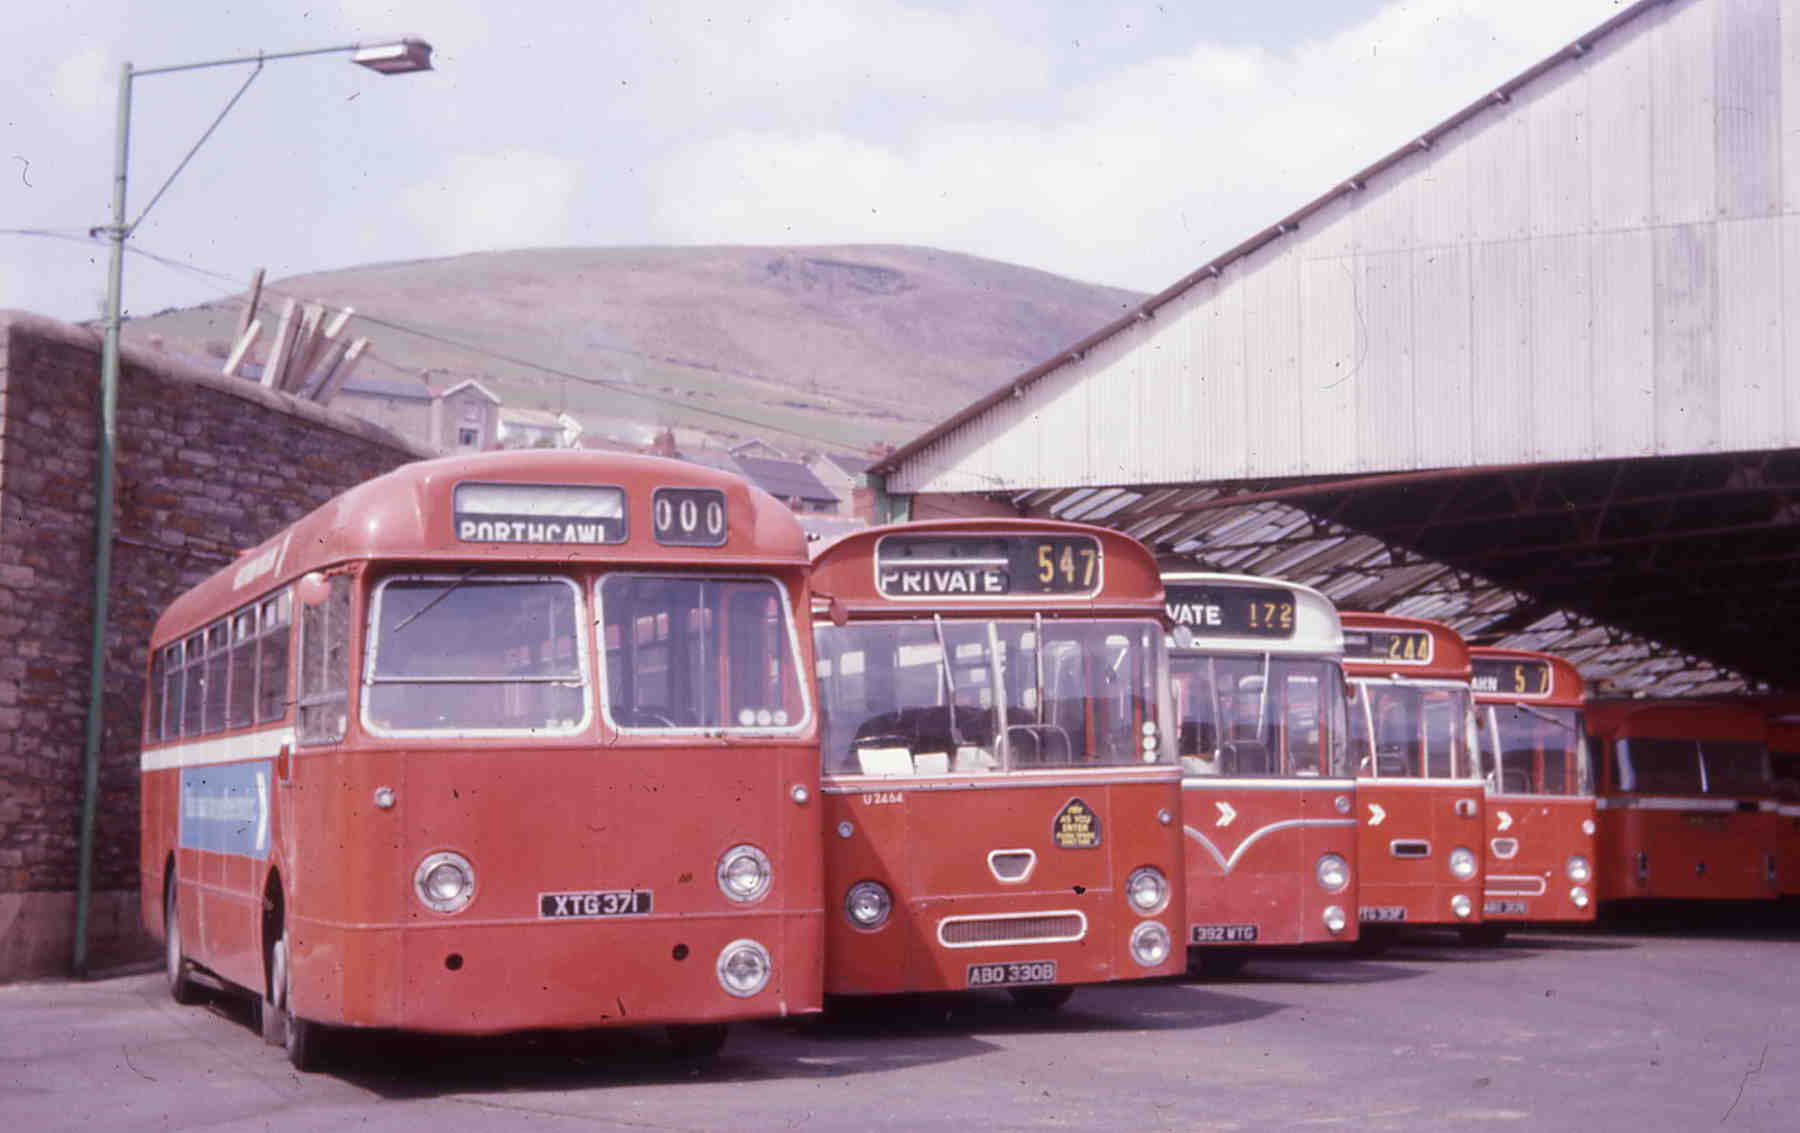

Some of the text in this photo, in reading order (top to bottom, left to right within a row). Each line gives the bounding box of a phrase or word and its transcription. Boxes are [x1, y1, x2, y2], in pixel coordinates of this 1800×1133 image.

[1037, 545, 1099, 587] 547
[880, 569, 1003, 593] PRIVATE
[1165, 603, 1222, 626] VATE
[1249, 603, 1293, 629] 172
